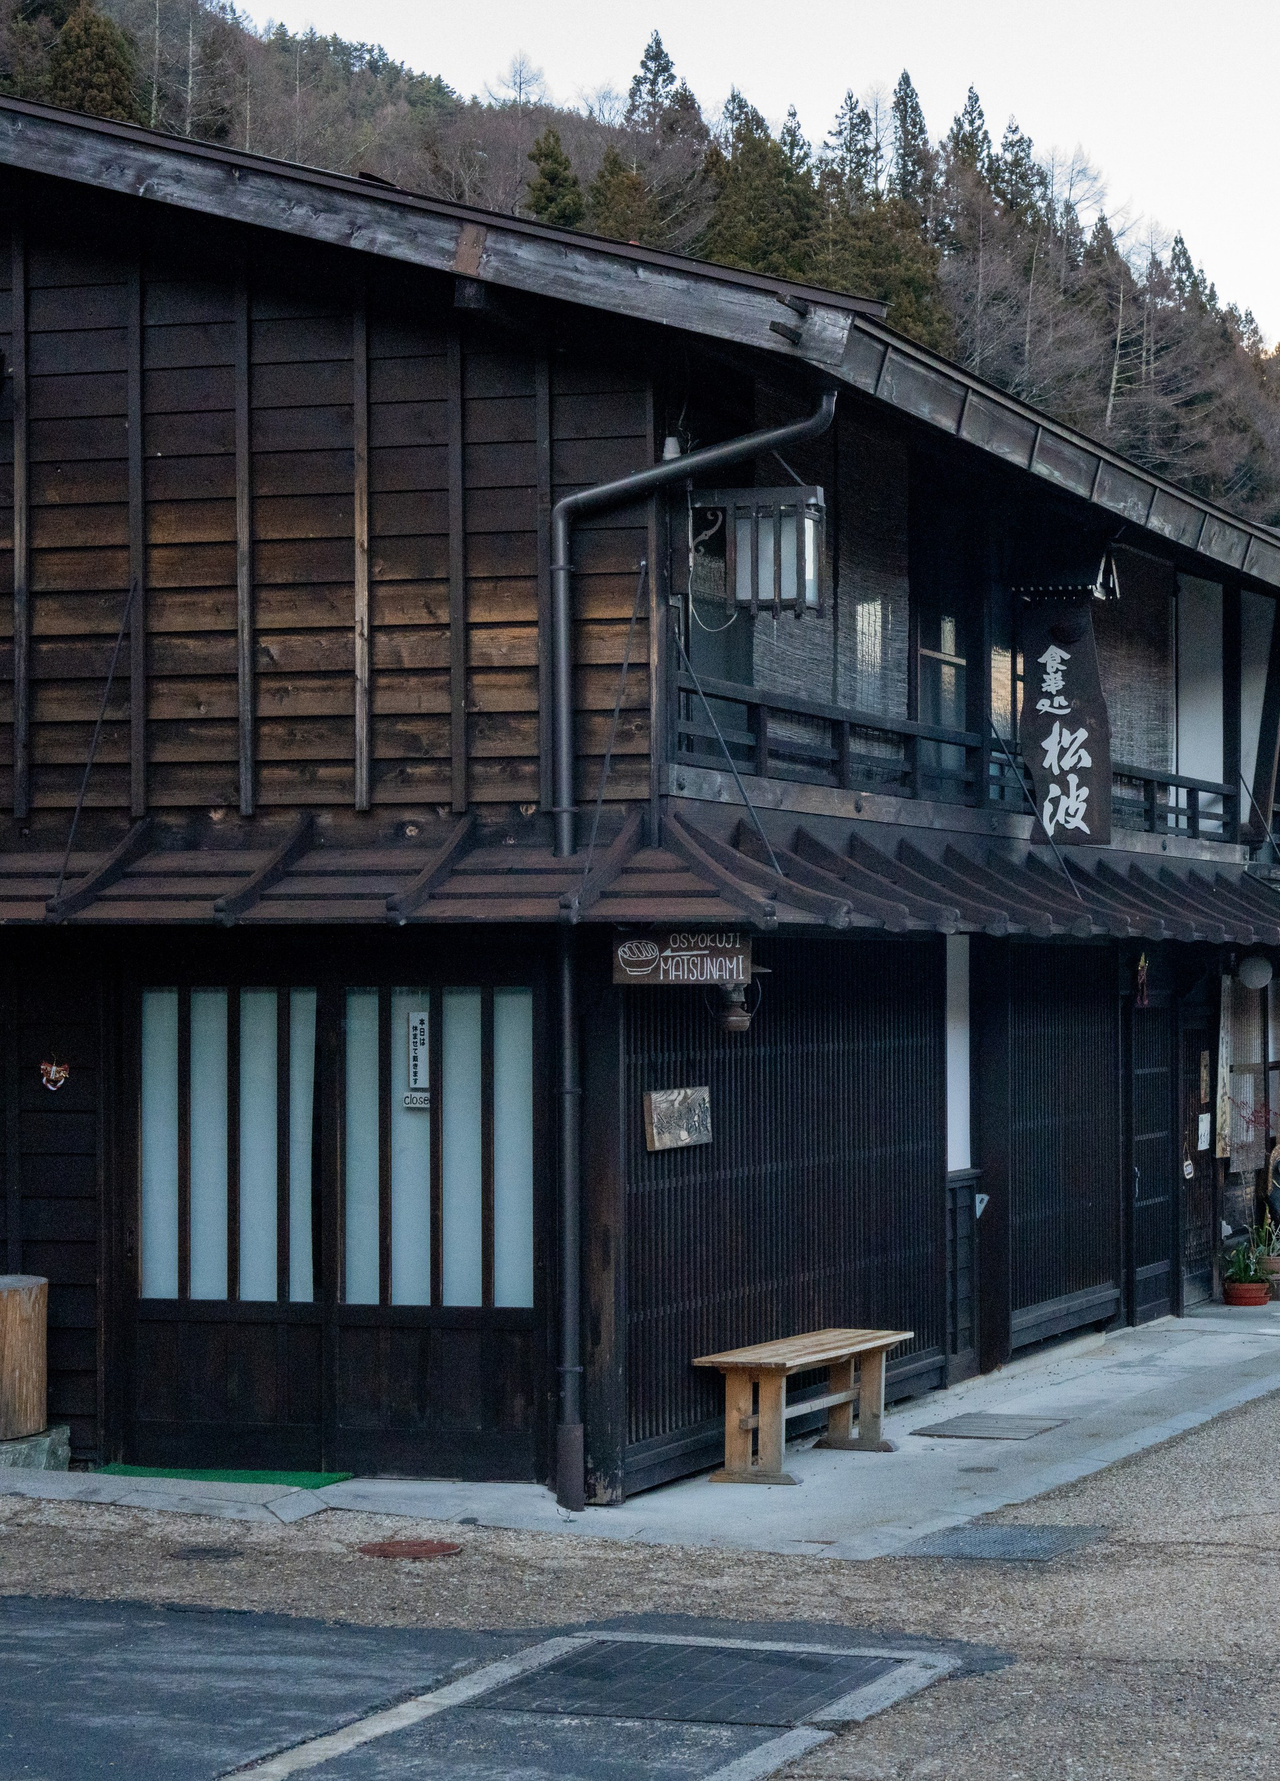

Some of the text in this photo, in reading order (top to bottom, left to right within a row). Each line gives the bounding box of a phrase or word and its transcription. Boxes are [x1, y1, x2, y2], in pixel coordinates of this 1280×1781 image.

[1041, 720, 1092, 837] 松波
[669, 933, 741, 949] OSYOKUJI
[660, 954, 744, 981] MATSUNAMI
[418, 1018, 426, 1046] 本日は
